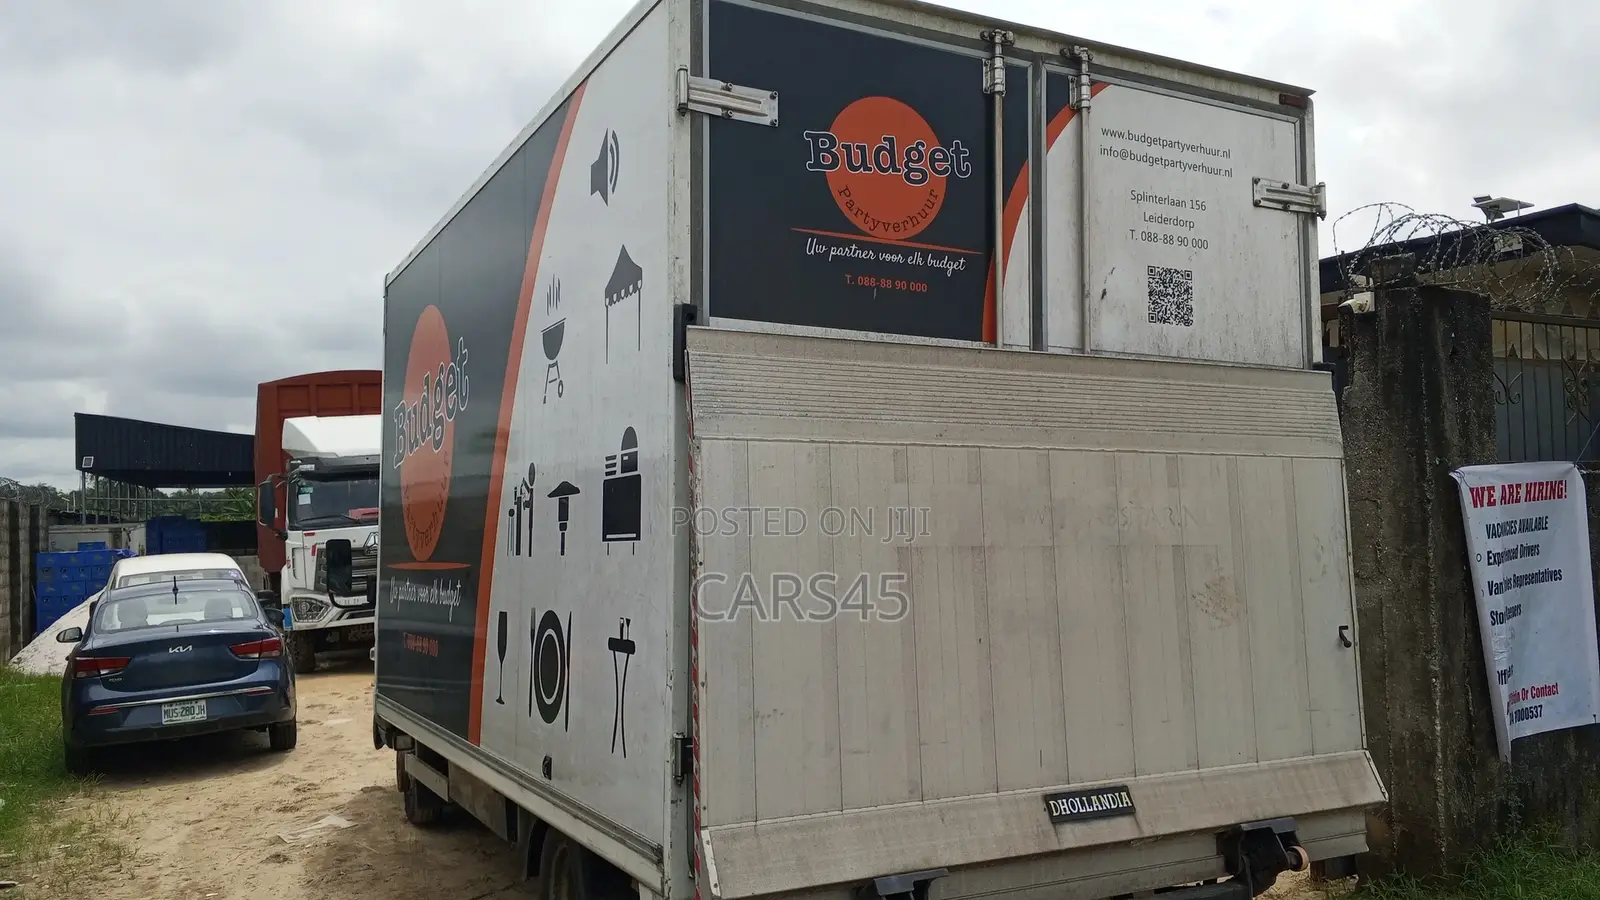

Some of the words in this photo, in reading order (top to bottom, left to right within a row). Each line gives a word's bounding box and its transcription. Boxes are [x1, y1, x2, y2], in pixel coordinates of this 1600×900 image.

[1101, 126, 1231, 159] www.budgetpartyverhuur.nl
[803, 131, 971, 187] Budget
[1100, 145, 1233, 178] info@budgetpartyverhuur.nl
[838, 185, 939, 233] Partyverhuur
[1130, 190, 1187, 209] Splinterlaan
[1189, 200, 1207, 211] 156
[1143, 212, 1195, 229] Leiderdorp
[1129, 229, 1138, 241] T.
[1141, 231, 1174, 245] 088-88
[1177, 236, 1189, 247] 90
[1191, 237, 1209, 250] 000
[806, 238, 828, 255] Uw
[828, 243, 876, 261] partner
[879, 251, 905, 264] voor
[908, 251, 925, 266] elk
[927, 253, 966, 276] budget
[845, 274, 854, 285] T.
[857, 276, 892, 289] 088-88
[895, 280, 907, 290] 90
[910, 281, 928, 292] 000
[393, 336, 469, 469] Budget
[1469, 486, 1496, 508] WE
[1500, 483, 1521, 505] ARE
[1524, 479, 1567, 502] HIRING!
[1518, 516, 1548, 534] AVAILABLE
[1519, 543, 1540, 559] Drivers
[1512, 567, 1562, 589] Representatives
[1521, 687, 1529, 702] Or
[1530, 682, 1559, 700] Contact
[1049, 791, 1132, 816] DHOLLANDIA
